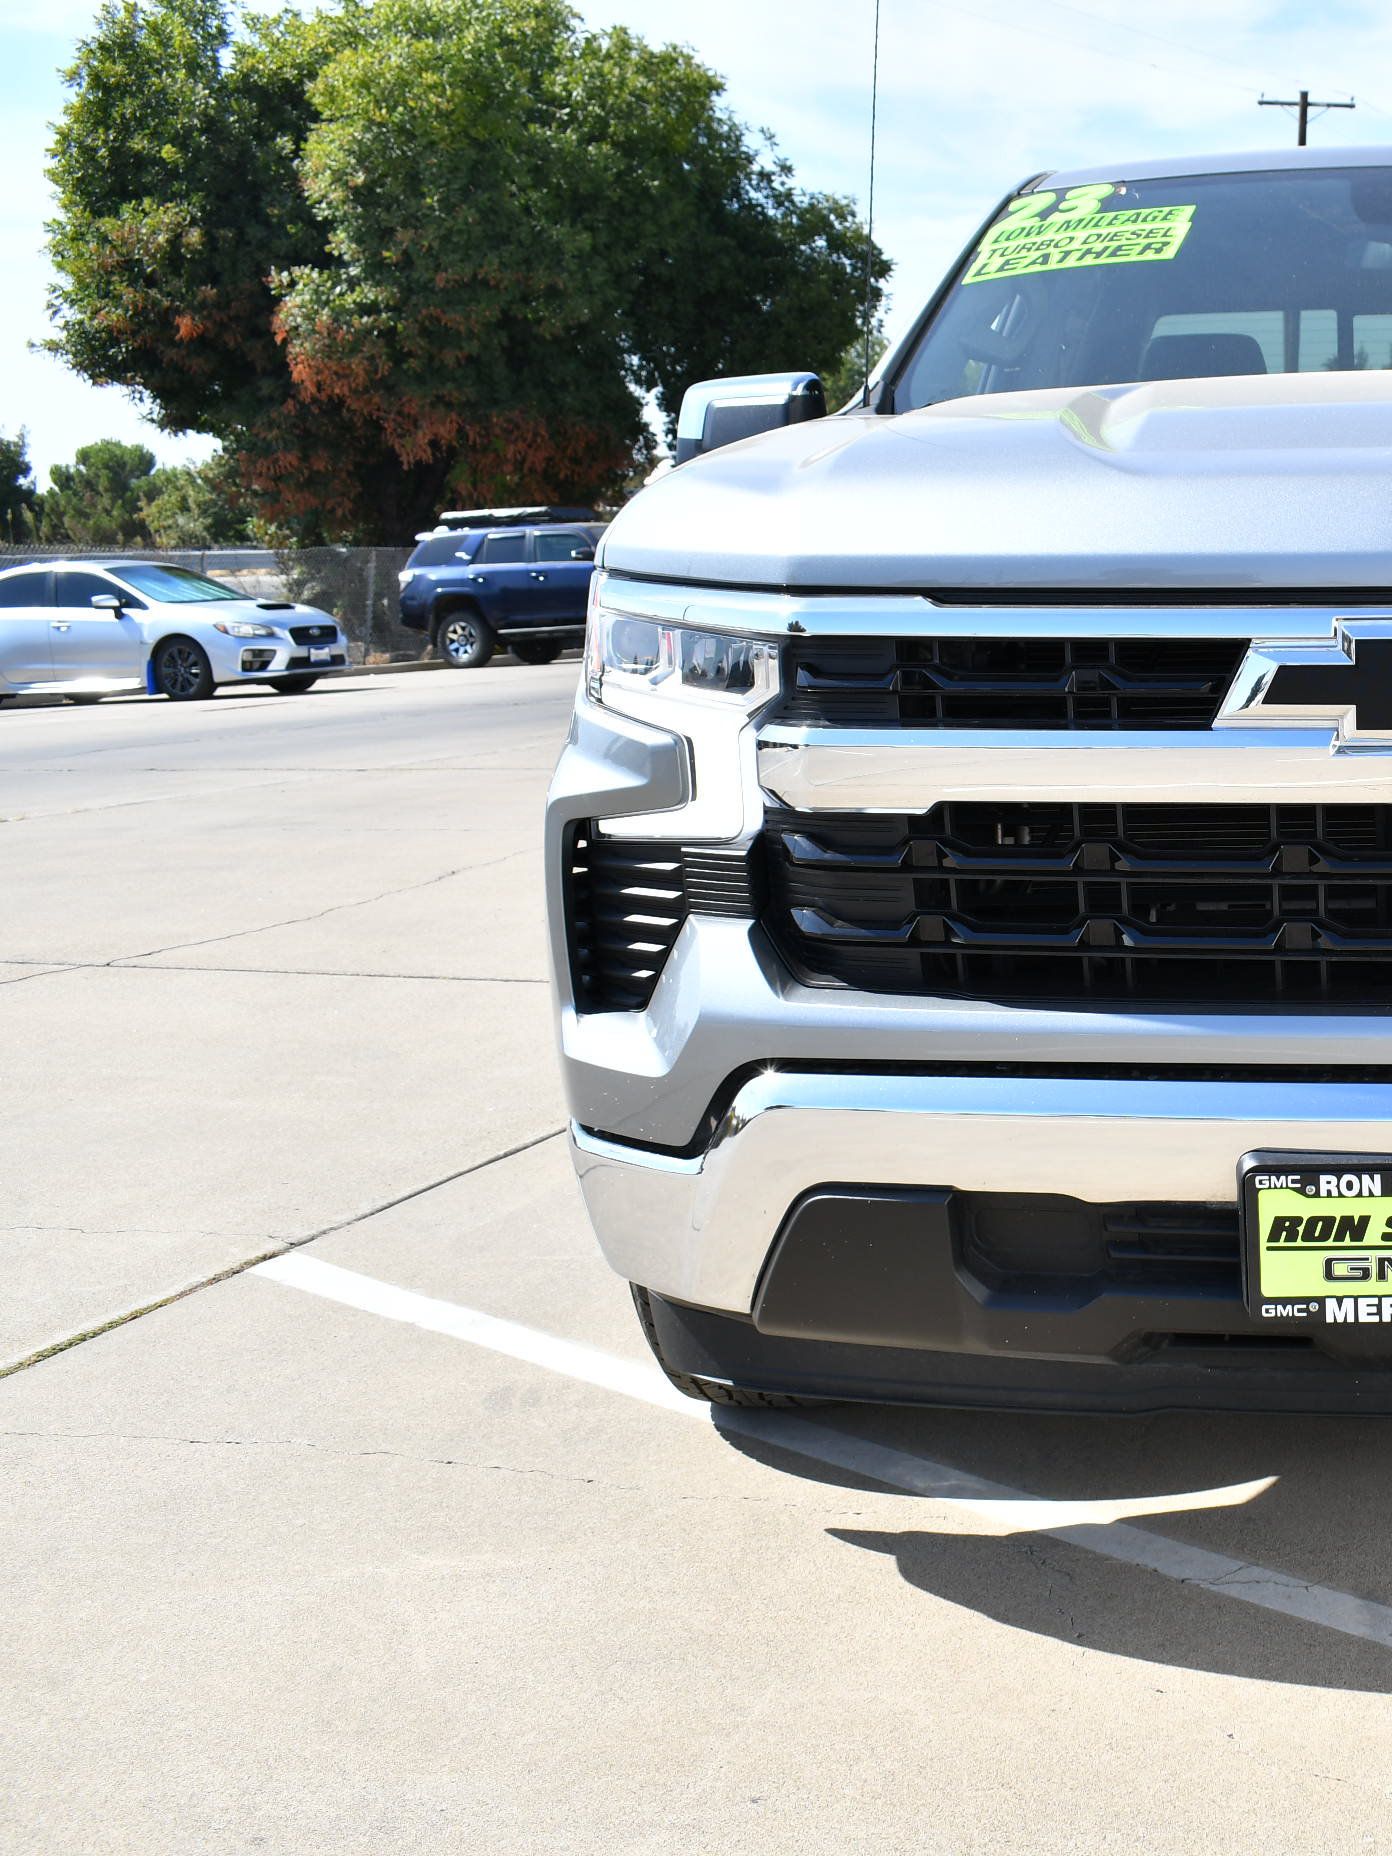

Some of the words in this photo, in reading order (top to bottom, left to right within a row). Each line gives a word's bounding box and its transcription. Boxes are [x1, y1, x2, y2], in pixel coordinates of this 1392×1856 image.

[1007, 183, 1115, 222] 23
[992, 220, 1053, 245] LOW
[1056, 207, 1182, 236] MILEAGE
[988, 235, 1074, 260] TURBO
[1081, 226, 1174, 246] DIESEL
[972, 241, 1171, 277] LEATHER
[1255, 1175, 1301, 1189] GMC
[1319, 1174, 1382, 1197] RON
[1266, 1215, 1371, 1243] RON
[1261, 1304, 1307, 1318] GMC
